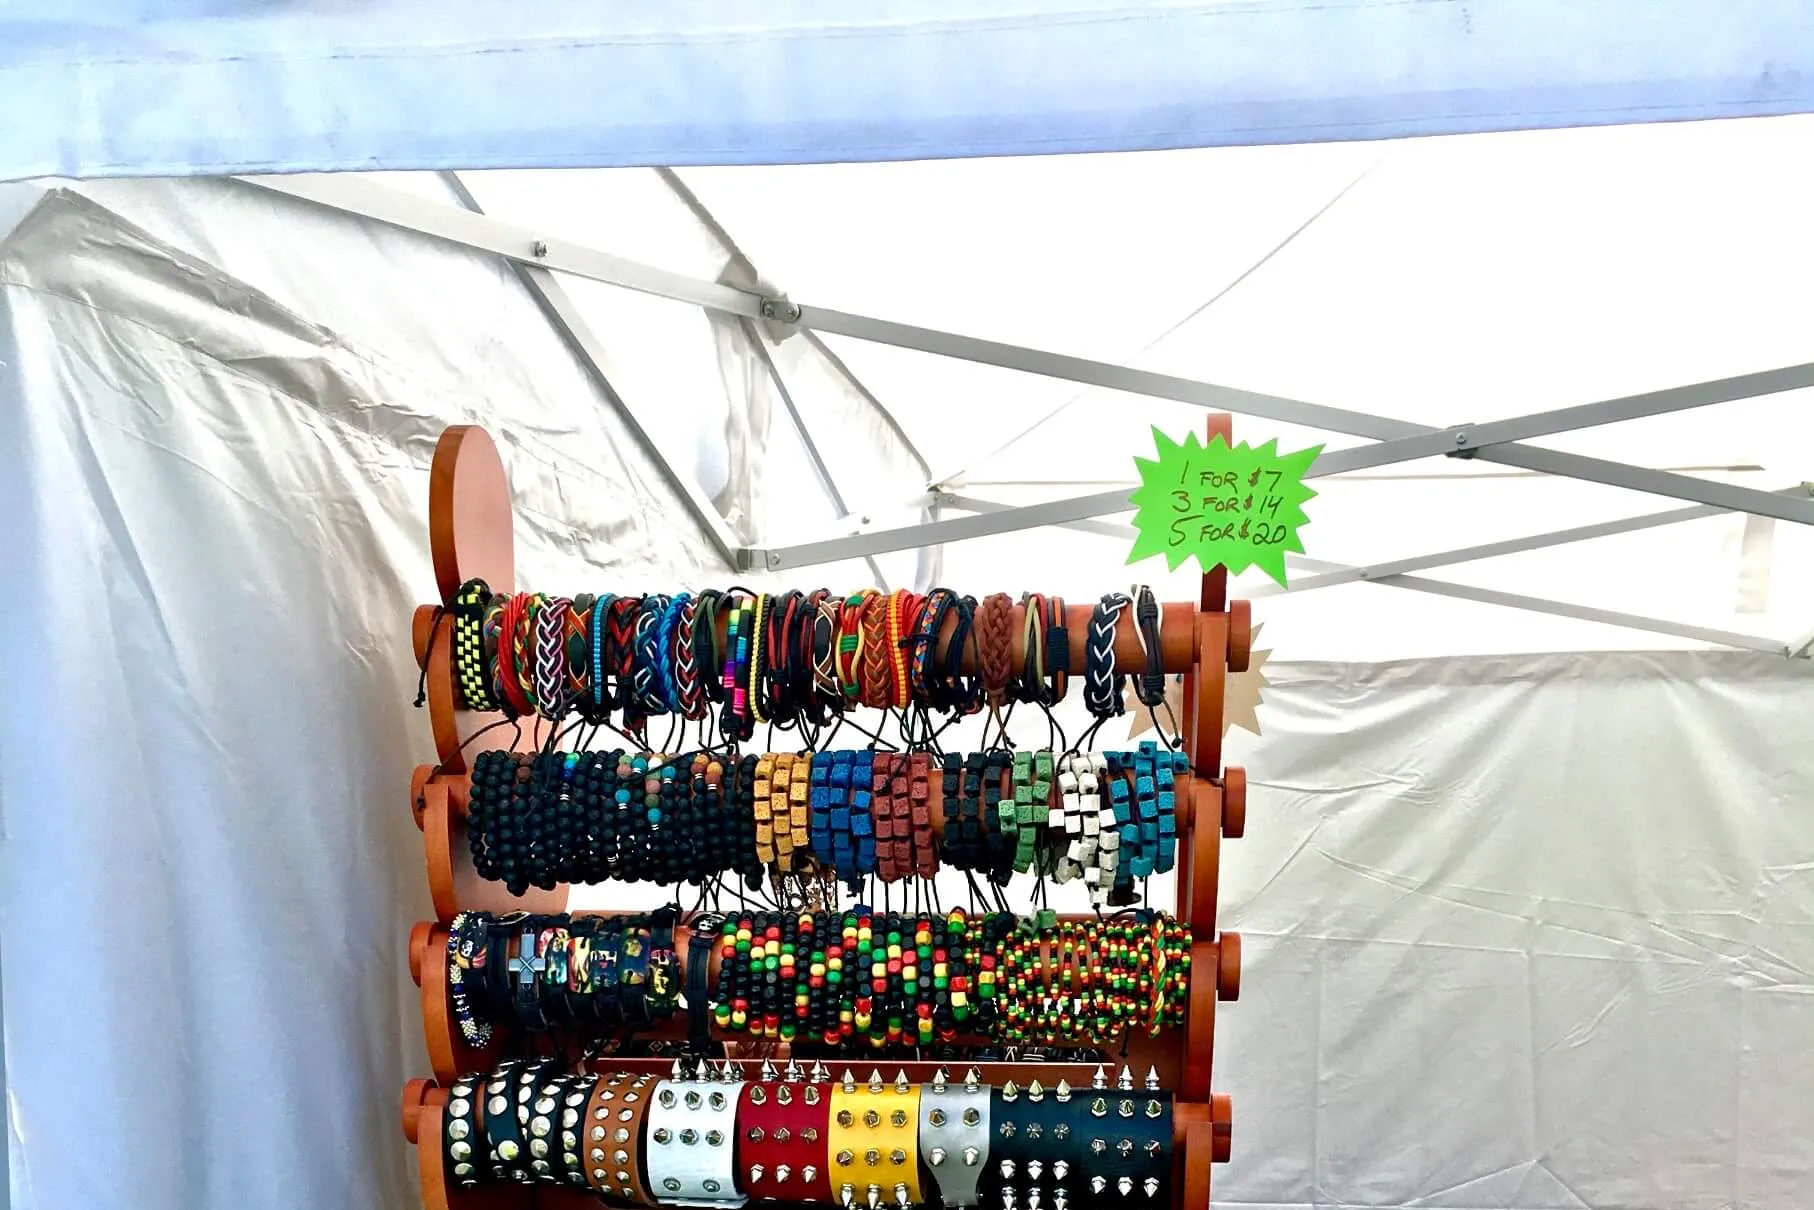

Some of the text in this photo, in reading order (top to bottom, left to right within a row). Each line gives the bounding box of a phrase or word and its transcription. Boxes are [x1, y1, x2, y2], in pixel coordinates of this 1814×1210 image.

[1180, 460, 1190, 484] 1
[1200, 472, 1239, 494] FOR
[1171, 490, 1192, 513] 3
[1202, 497, 1241, 514] FOR
[1168, 515, 1287, 546] 5 FOR $20
